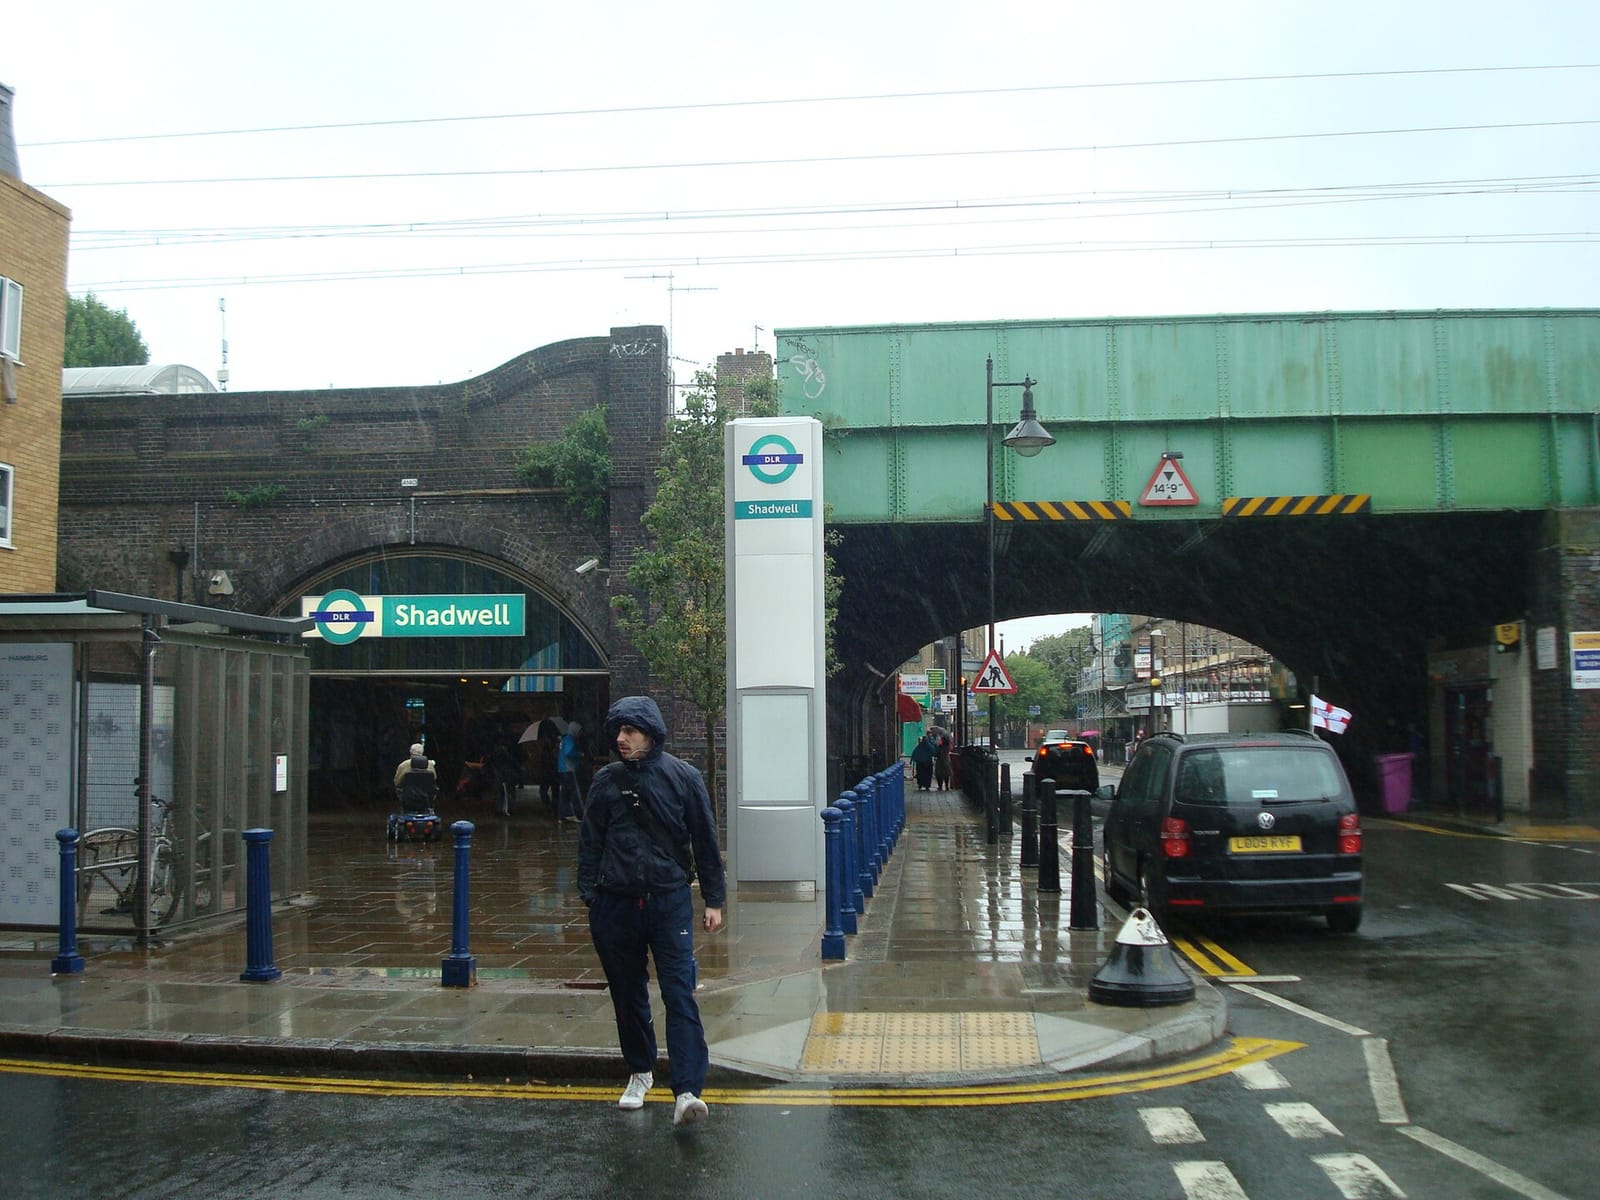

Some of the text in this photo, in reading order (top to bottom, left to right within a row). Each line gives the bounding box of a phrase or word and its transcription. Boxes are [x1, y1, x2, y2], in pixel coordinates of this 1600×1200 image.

[748, 503, 799, 514] Shadwell
[332, 613, 350, 621] DLR
[394, 603, 510, 626] Shadwell
